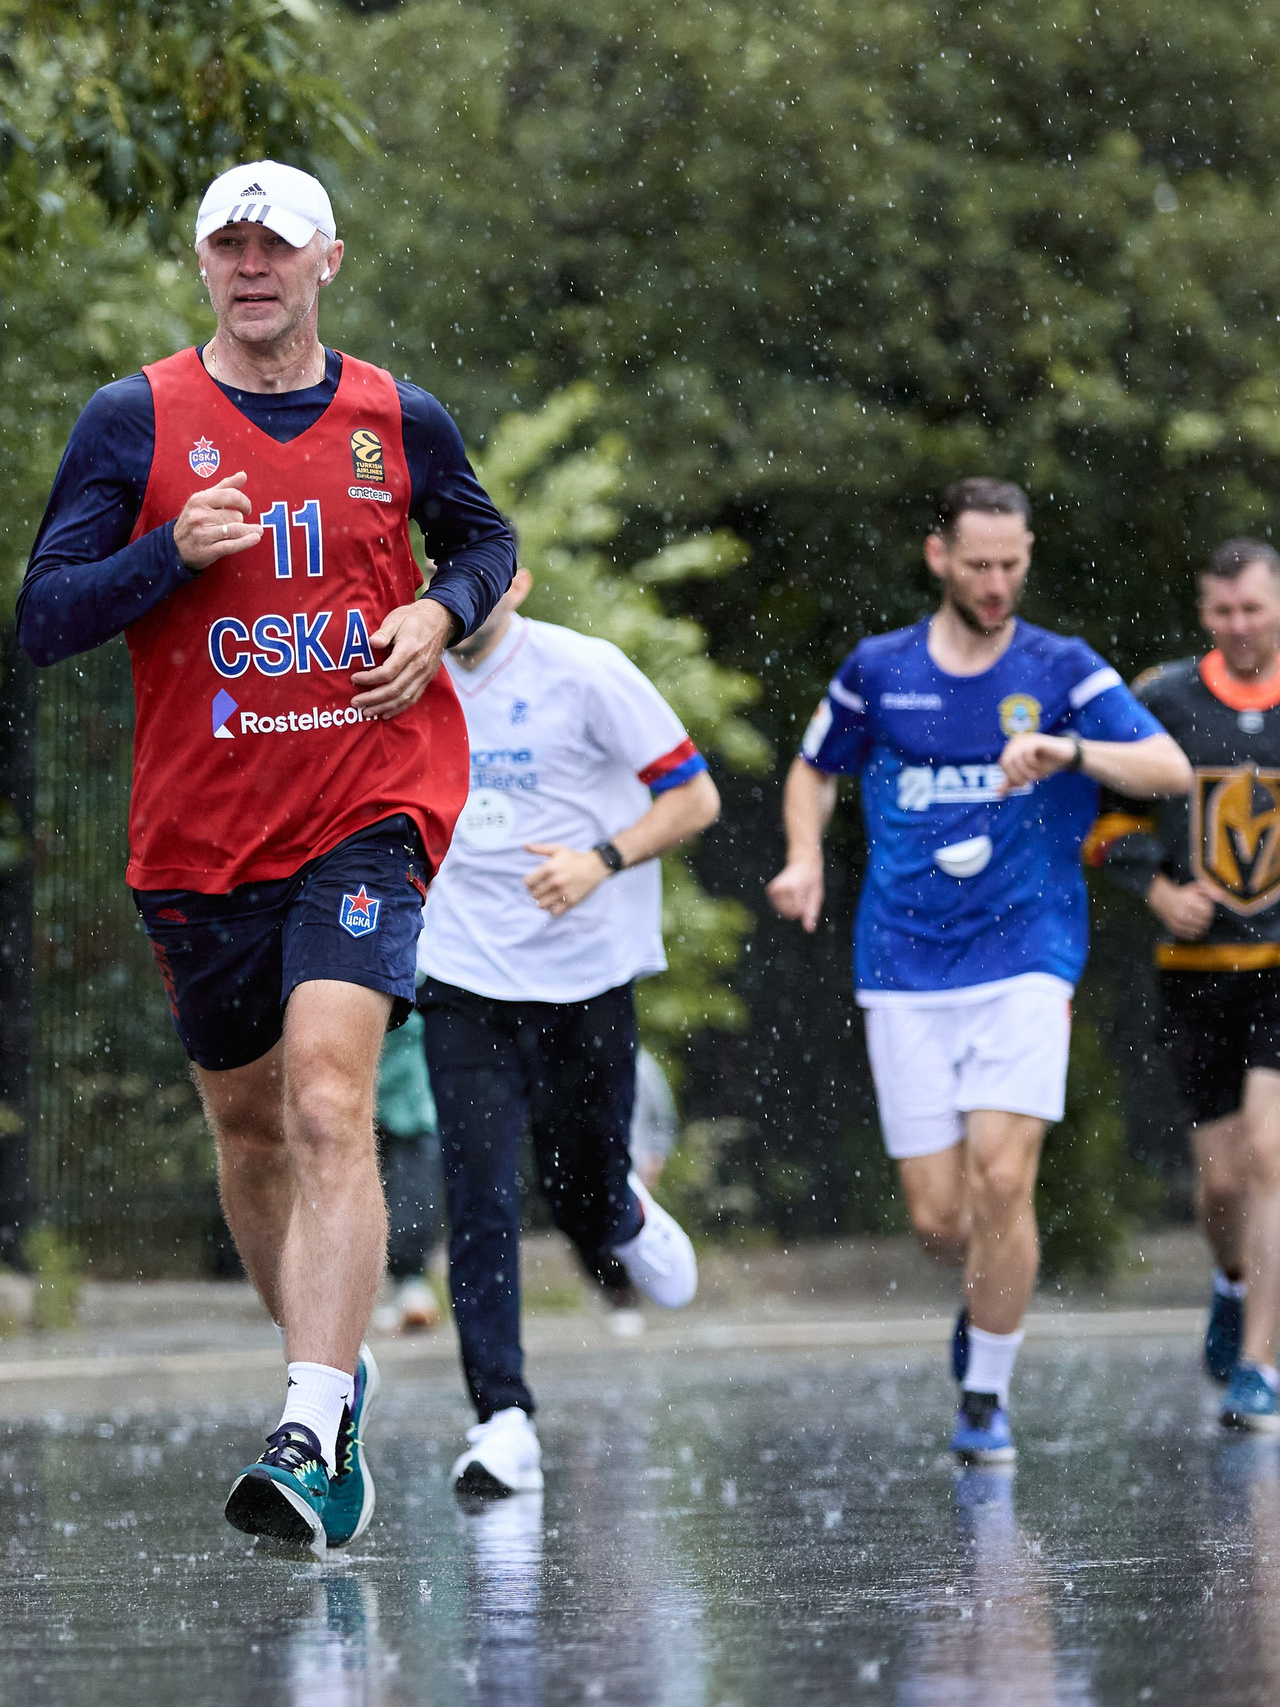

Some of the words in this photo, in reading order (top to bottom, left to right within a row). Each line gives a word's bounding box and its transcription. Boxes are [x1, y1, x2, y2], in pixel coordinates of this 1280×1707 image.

[192, 452, 217, 462] CSKA
[260, 499, 324, 579] 11
[207, 608, 376, 679] CSKA
[346, 914, 371, 928] ЦСКА
